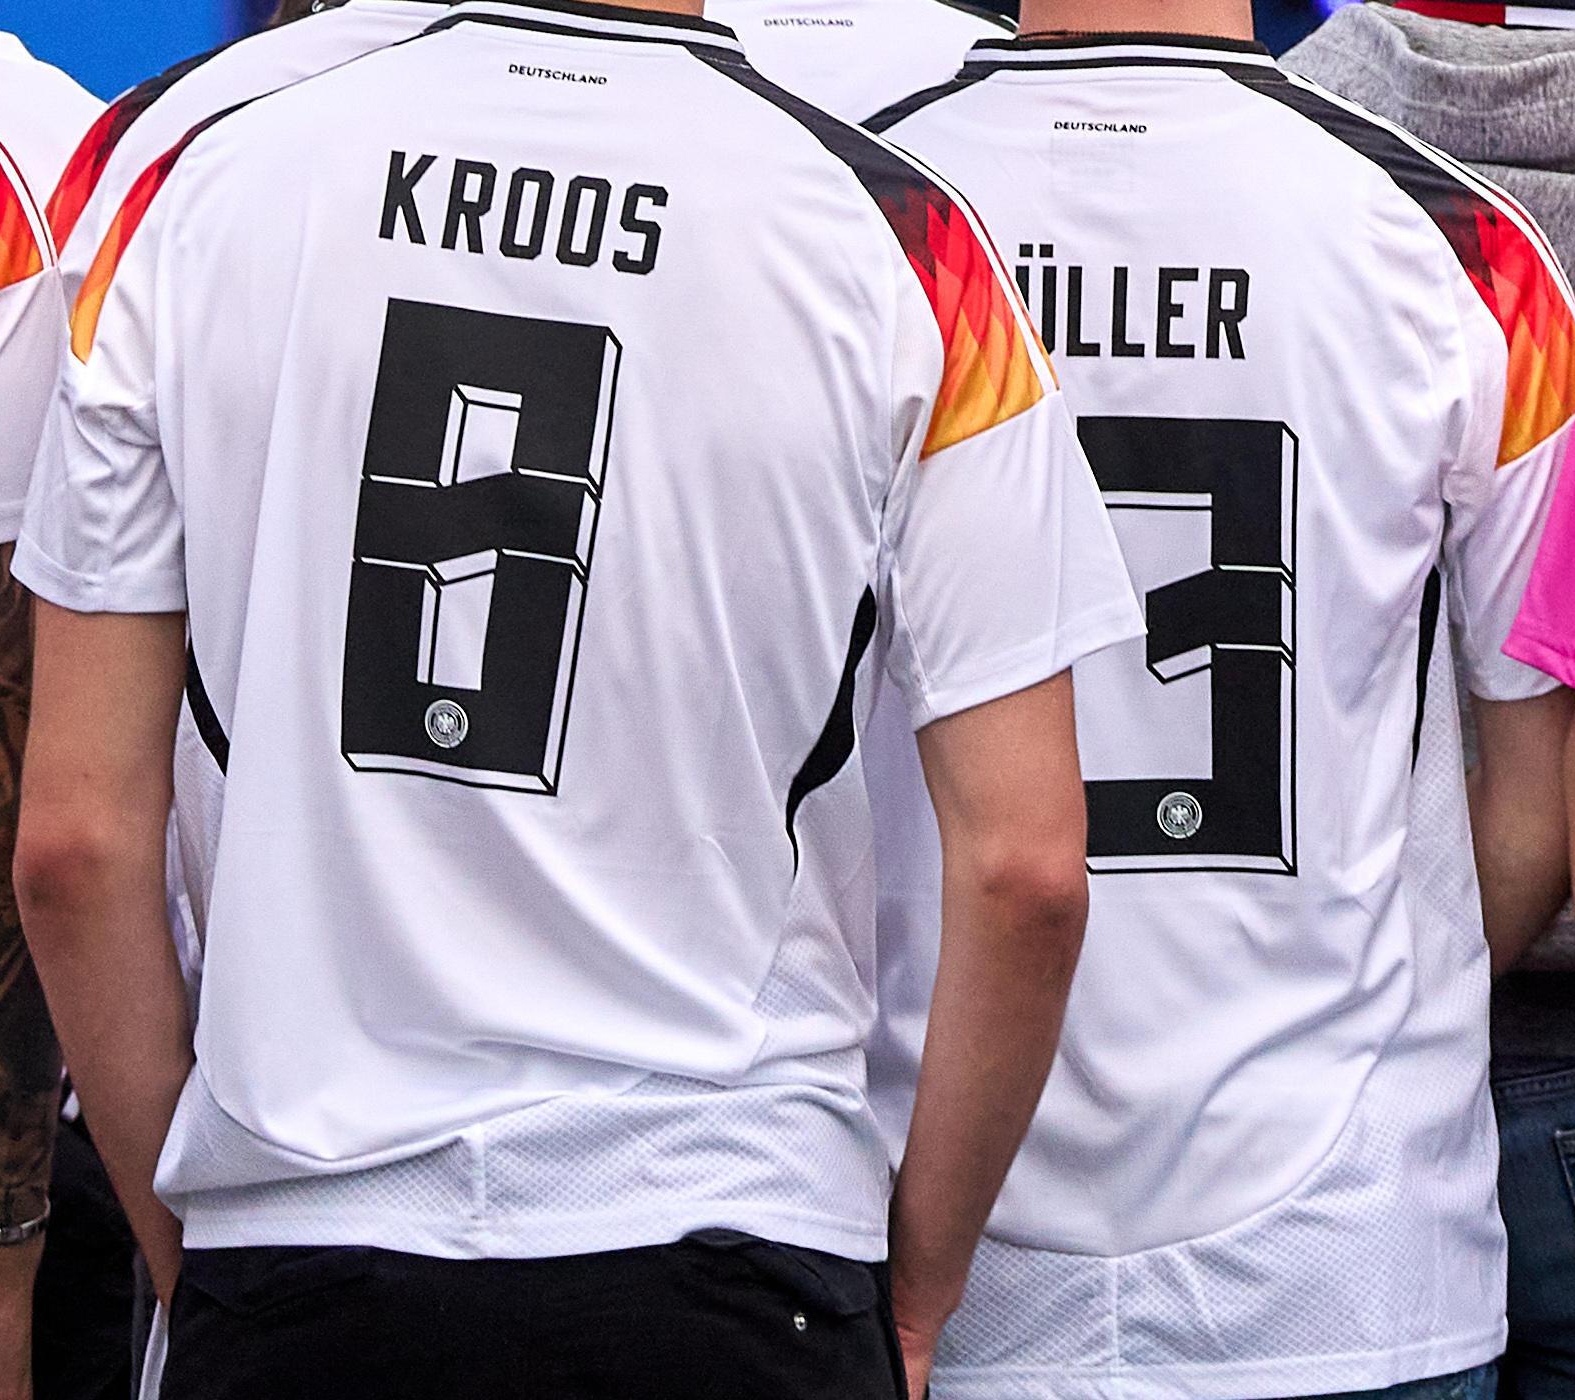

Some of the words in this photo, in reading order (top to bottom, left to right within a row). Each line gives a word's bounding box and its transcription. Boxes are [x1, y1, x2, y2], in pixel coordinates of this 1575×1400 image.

[763, 17, 854, 29] DEUTSCHLAND
[508, 63, 608, 86] DEUTSCHLAND
[1053, 121, 1147, 134] DEUTSCHLAND
[378, 149, 669, 276] KROOS
[1015, 243, 1250, 360] ÜLLER
[340, 296, 624, 798] 8
